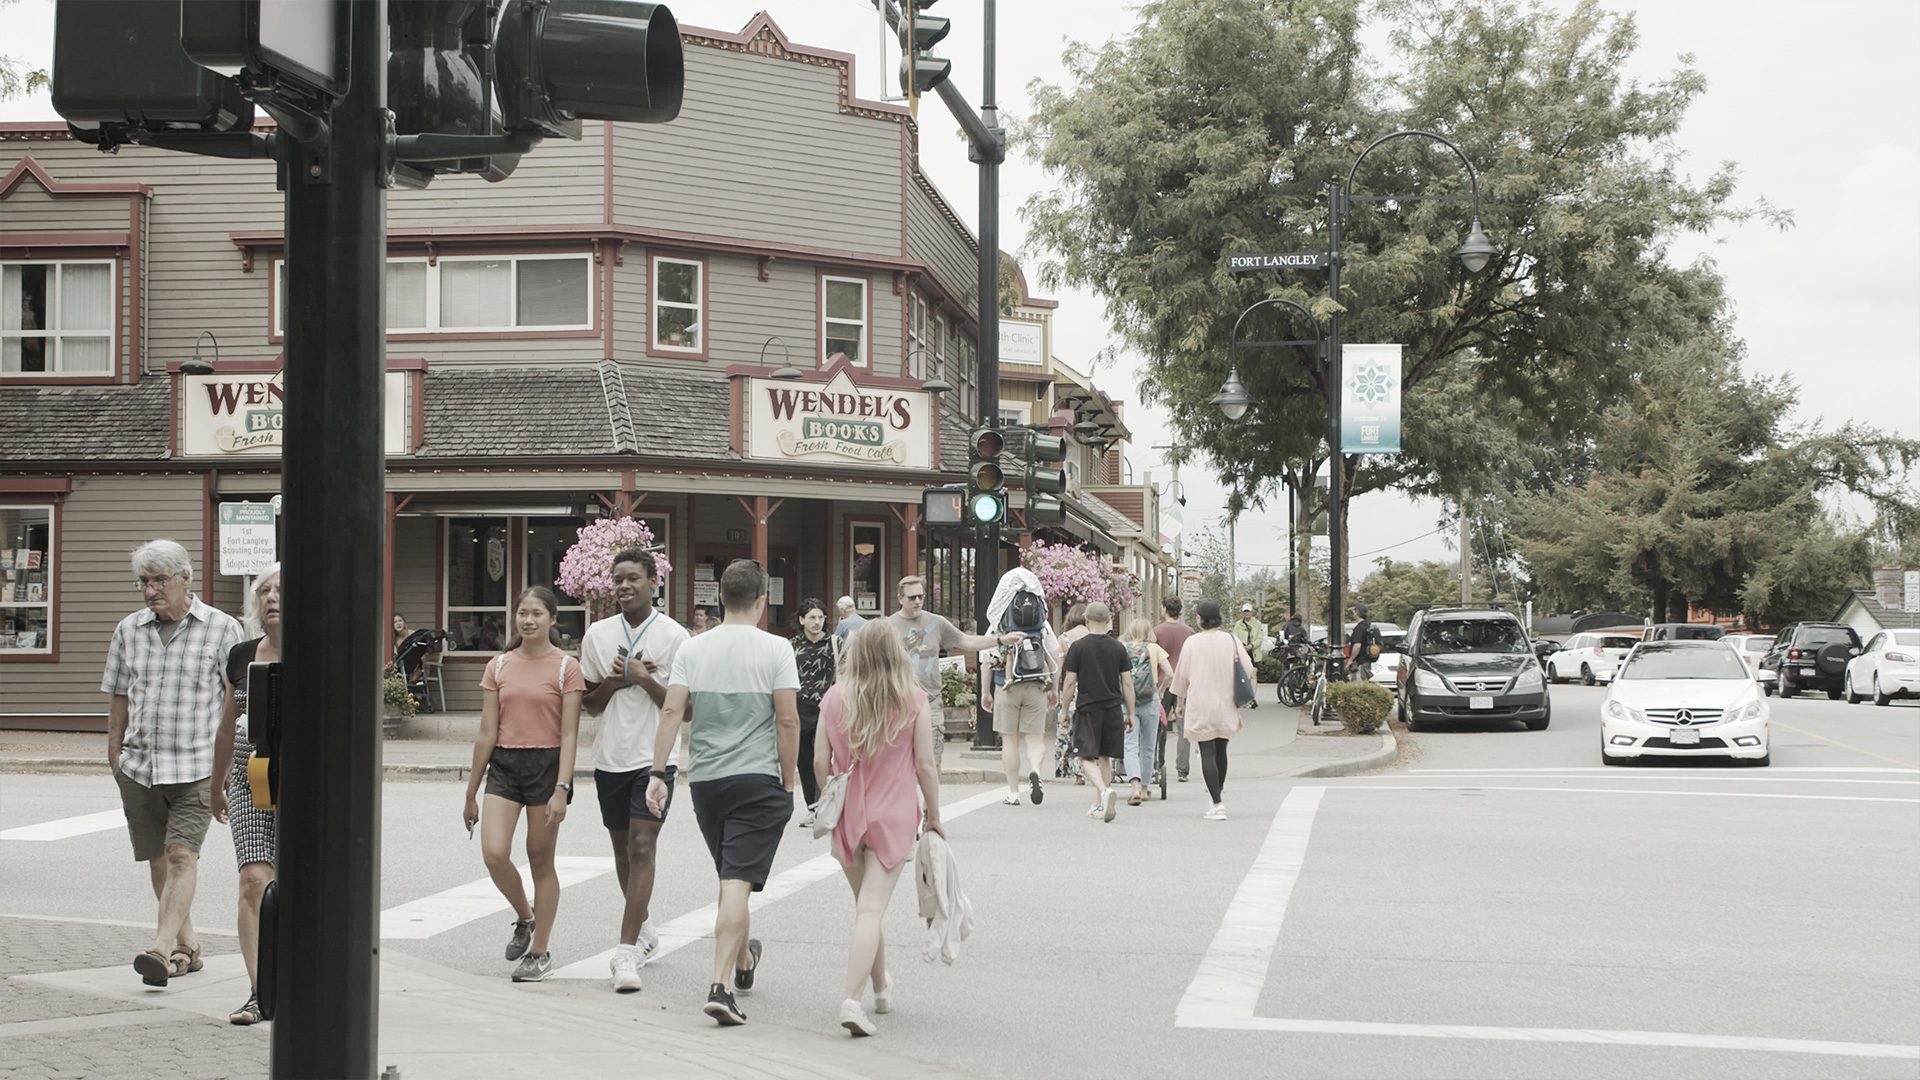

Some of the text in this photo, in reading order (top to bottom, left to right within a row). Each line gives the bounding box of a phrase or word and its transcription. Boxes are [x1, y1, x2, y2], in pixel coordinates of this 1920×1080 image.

[1231, 254, 1319, 267] FORT LANGLEY
[766, 387, 911, 430] WENDEL'S
[232, 431, 274, 448] Fresh
[809, 421, 880, 442] BOOKS
[794, 439, 829, 453] Fresh
[835, 441, 862, 457] Food
[952, 496, 961, 519] 4
[241, 527, 252, 535] 1st
[227, 536, 269, 546] Fort Langley
[222, 546, 274, 555] Scouting Group
